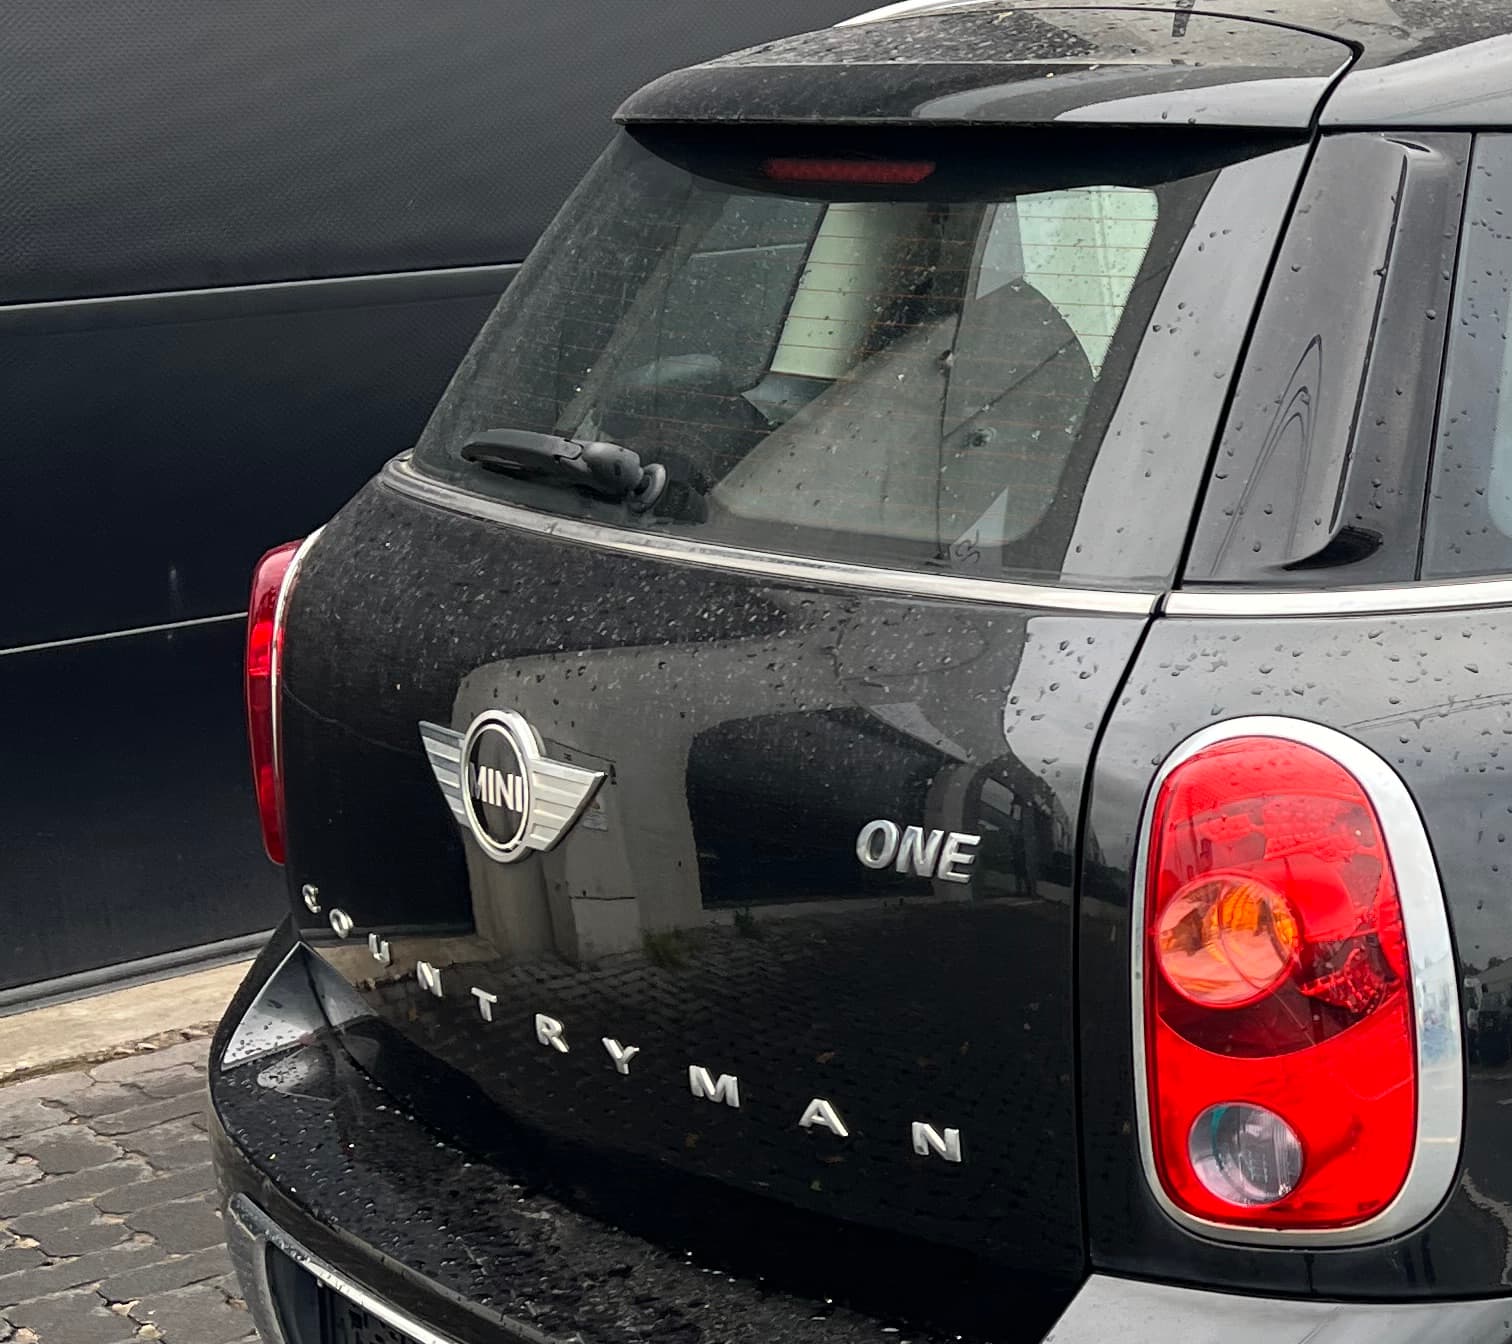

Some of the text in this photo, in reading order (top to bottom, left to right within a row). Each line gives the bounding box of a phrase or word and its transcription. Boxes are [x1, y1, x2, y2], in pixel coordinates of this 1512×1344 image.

[469, 761, 523, 813] MINI
[856, 819, 982, 884] ONE
[301, 884, 962, 1162] COUNTRYMAN
